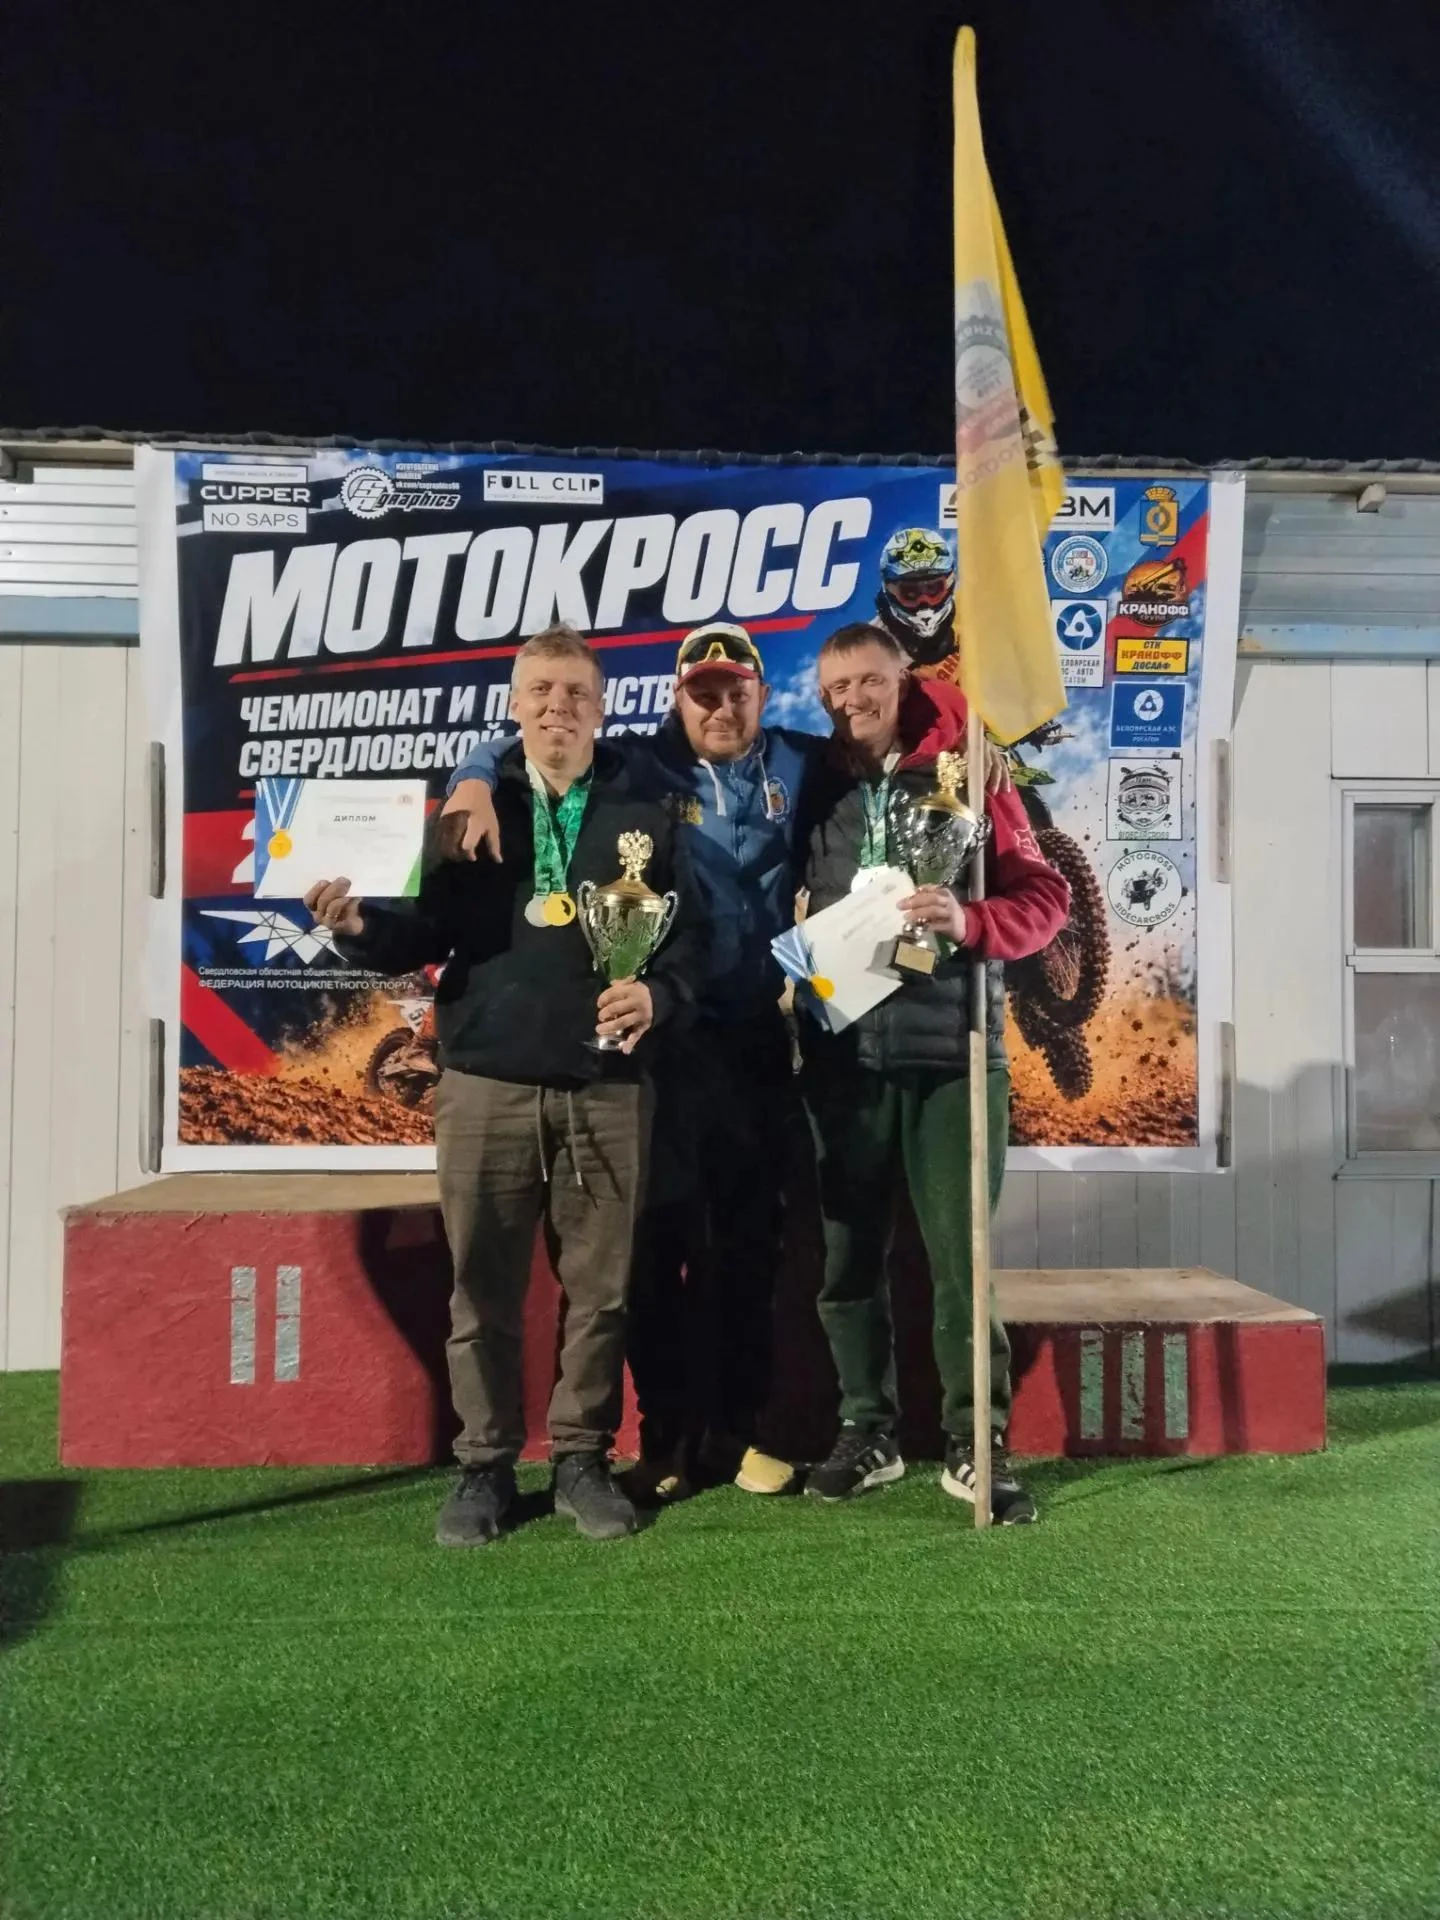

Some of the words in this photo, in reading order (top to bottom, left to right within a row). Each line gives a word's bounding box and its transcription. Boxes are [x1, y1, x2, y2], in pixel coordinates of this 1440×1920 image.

[487, 475, 540, 490] FULL
[552, 477, 600, 491] CLIP
[200, 485, 311, 503] CUPPER
[376, 491, 460, 512] graphics
[211, 513, 240, 527] NO
[246, 513, 299, 527] SAPS
[213, 497, 872, 667] МОТОКРОСС
[1119, 603, 1189, 616] КРАНОФФ
[1121, 650, 1183, 661] КРАНОФФ
[1060, 659, 1100, 667] ЕЛОЯРСКАЯ
[1131, 661, 1172, 671] ДОСААФ
[239, 687, 443, 732] ЧЕМПИОНАТ
[448, 684, 477, 723] И
[333, 815, 377, 823] ДИПЛОМ
[1116, 852, 1174, 872] MOTOCROSS
[1114, 902, 1175, 924] SIDECARCROSS
[198, 966, 257, 976] Свердловская
[259, 967, 302, 977] областная
[198, 979, 264, 989] ФЕДЕРАЦИЯ
[266, 979, 371, 990] МОТОЦИКЛЕТНОГО
[372, 981, 415, 990] СПОРТА
